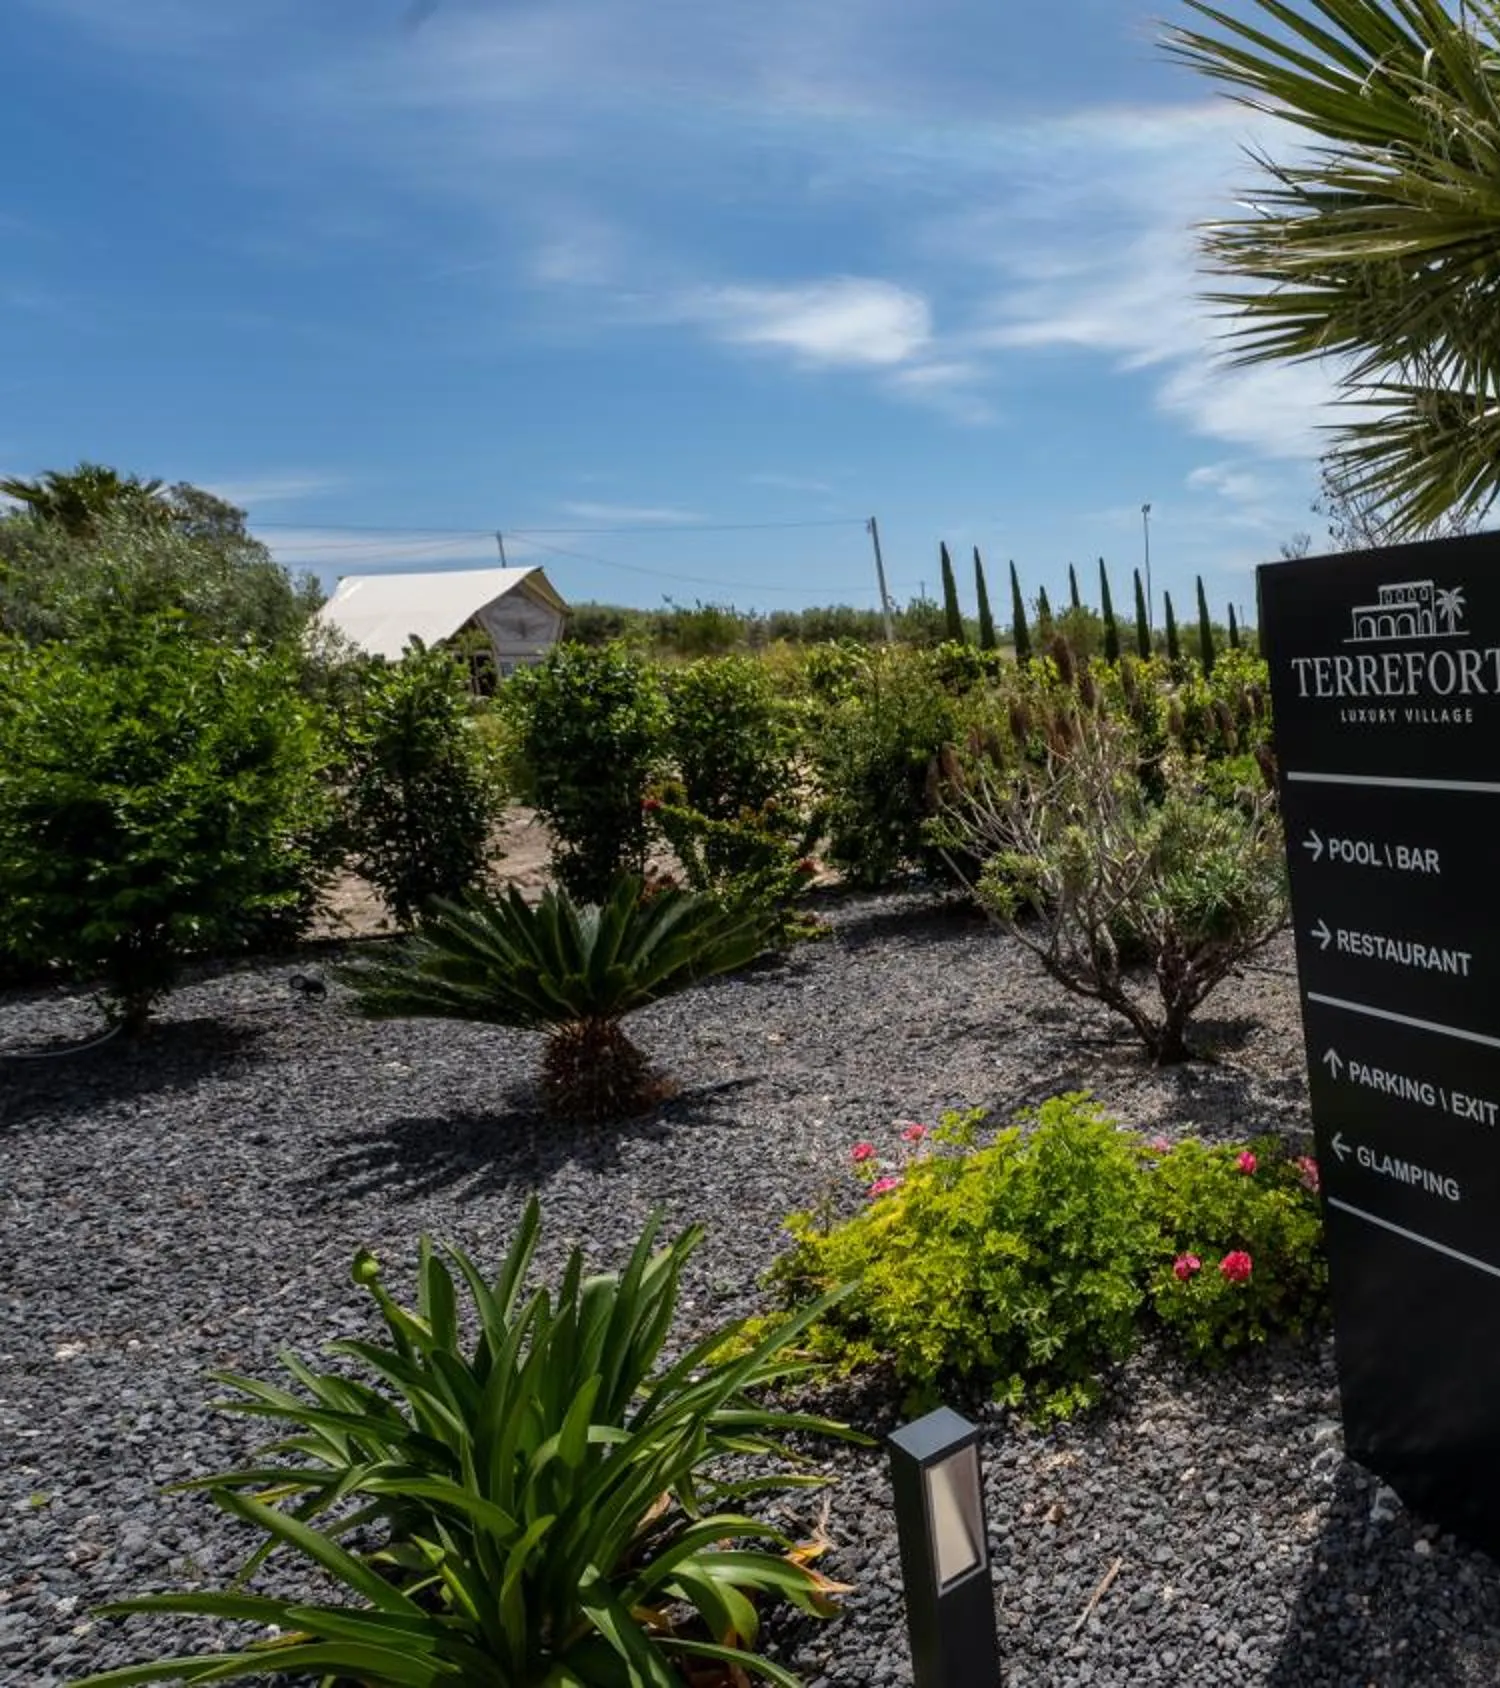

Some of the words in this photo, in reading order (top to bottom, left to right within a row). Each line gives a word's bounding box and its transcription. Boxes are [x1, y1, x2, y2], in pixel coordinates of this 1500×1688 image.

[1340, 708, 1397, 723] LUXURY
[1405, 707, 1474, 723] VILLAGE
[1329, 838, 1383, 867] POOL
[1396, 845, 1441, 874] BAR
[1336, 929, 1472, 977] RESTAURANT
[1349, 1061, 1436, 1106] PARKING
[1451, 1091, 1499, 1127] EXIT
[1357, 1145, 1460, 1201] GLAMPING
